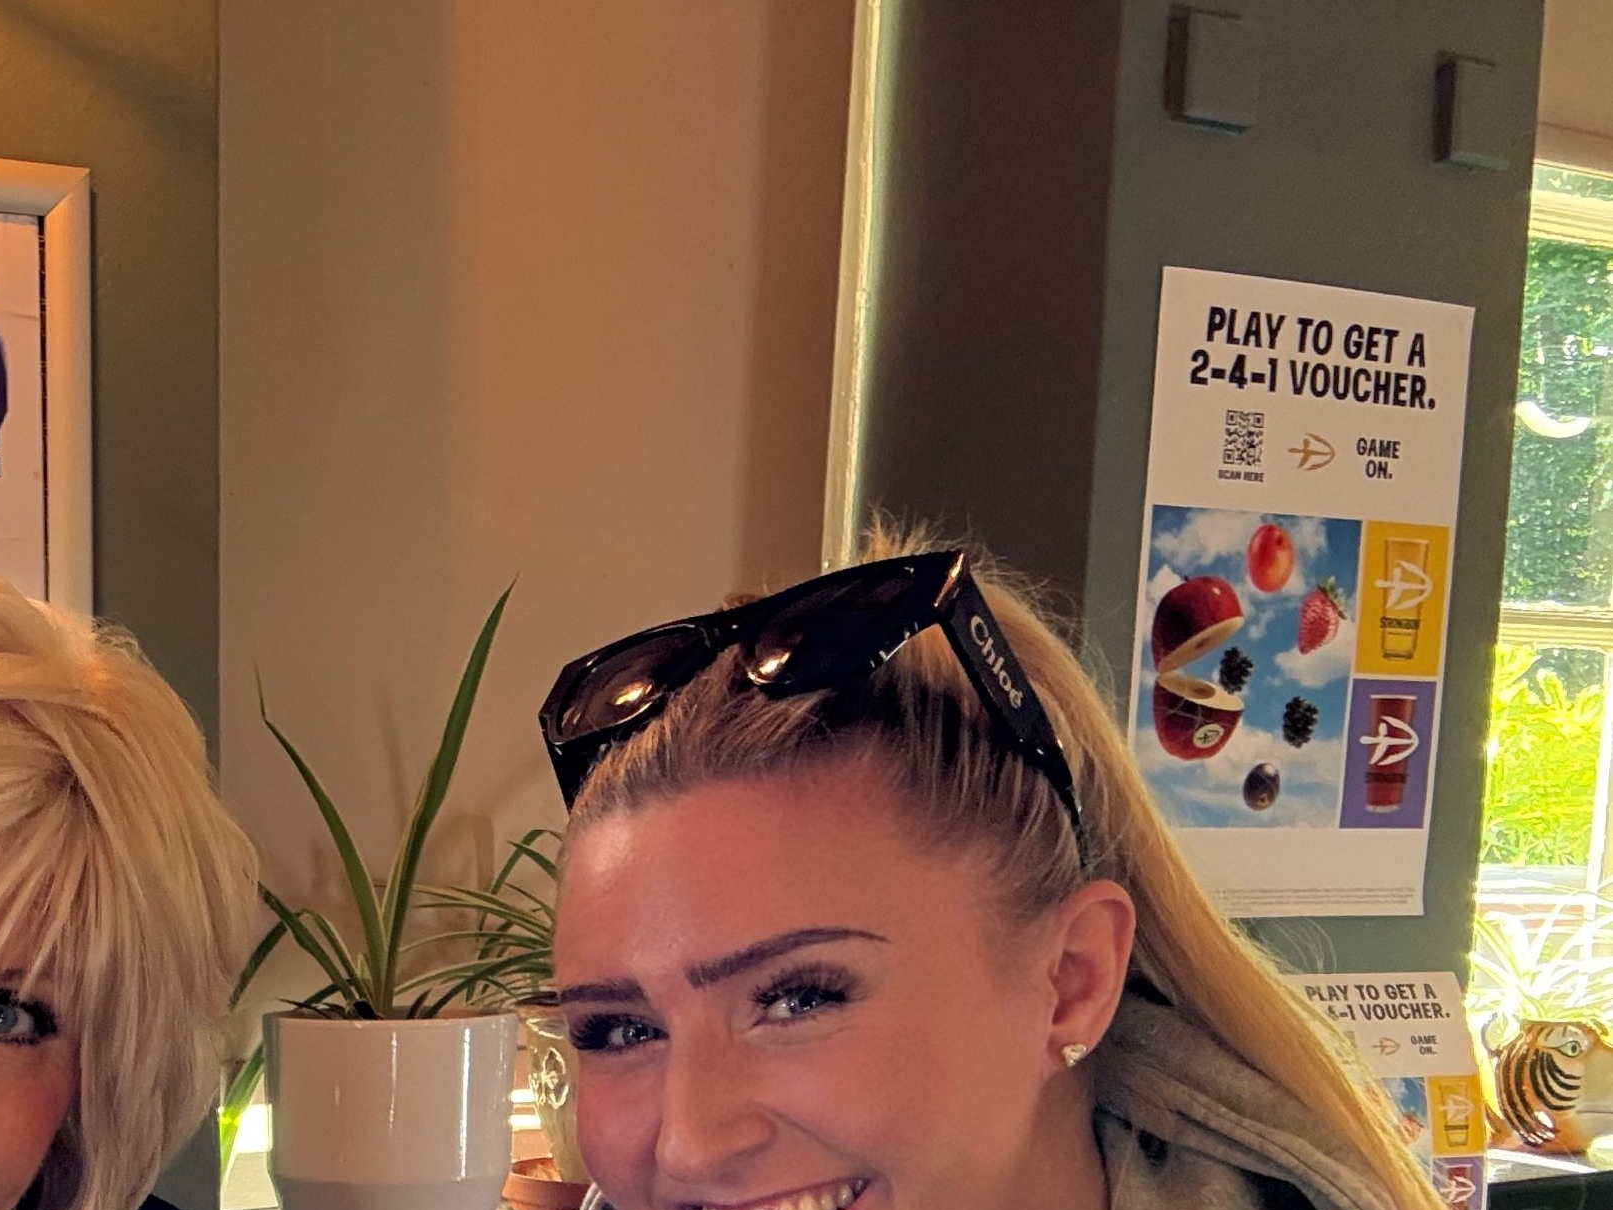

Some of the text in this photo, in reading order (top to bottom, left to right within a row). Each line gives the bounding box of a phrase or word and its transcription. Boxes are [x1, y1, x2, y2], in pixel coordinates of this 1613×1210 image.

[1206, 306, 1426, 368] PLAY TO GET A
[1189, 349, 1437, 410] 2-4-1 VOUCHER.
[1356, 437, 1401, 459] GAME
[1218, 469, 1265, 483] SCAN HERE
[1365, 459, 1393, 480] ON.
[1304, 983, 1437, 1002] PLAY TO GET A
[1358, 1002, 1451, 1021] VOUCHER.
[1410, 1035, 1438, 1045] GAME
